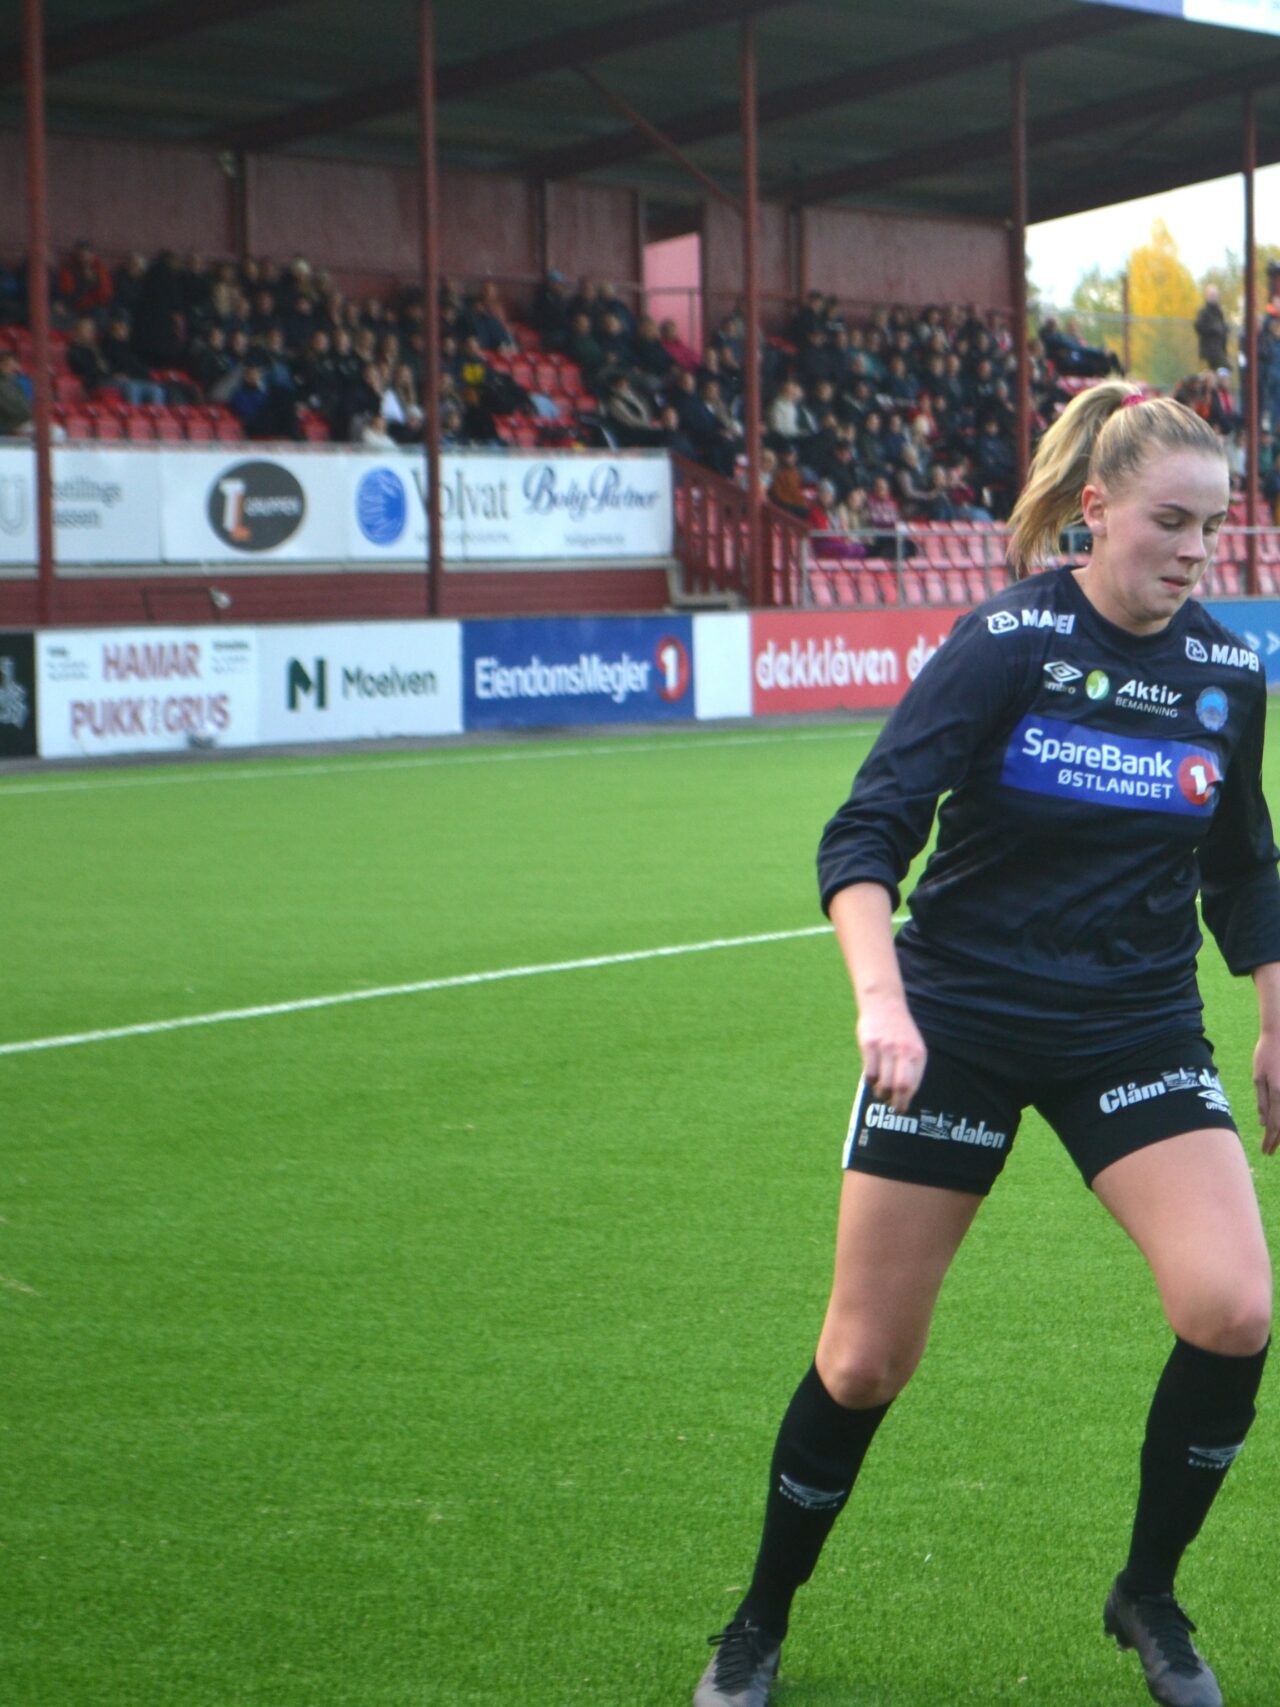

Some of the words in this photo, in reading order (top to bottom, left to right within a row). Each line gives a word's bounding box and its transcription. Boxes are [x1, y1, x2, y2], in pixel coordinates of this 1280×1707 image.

[1021, 608, 1076, 635] MAEI
[102, 642, 202, 682] HAMAR
[755, 636, 899, 690] dekklåven
[1211, 643, 1260, 673] MAPEI
[342, 666, 438, 698] Moelven
[475, 652, 651, 703] EiendomsMegler
[1116, 679, 1183, 706] Aktiv
[70, 698, 147, 740] PUKK
[1115, 695, 1179, 718] BEMANNING
[1021, 727, 1174, 779] SpareBank
[1056, 768, 1175, 800] ØSTLANDET
[950, 1117, 1007, 1149] dalen
